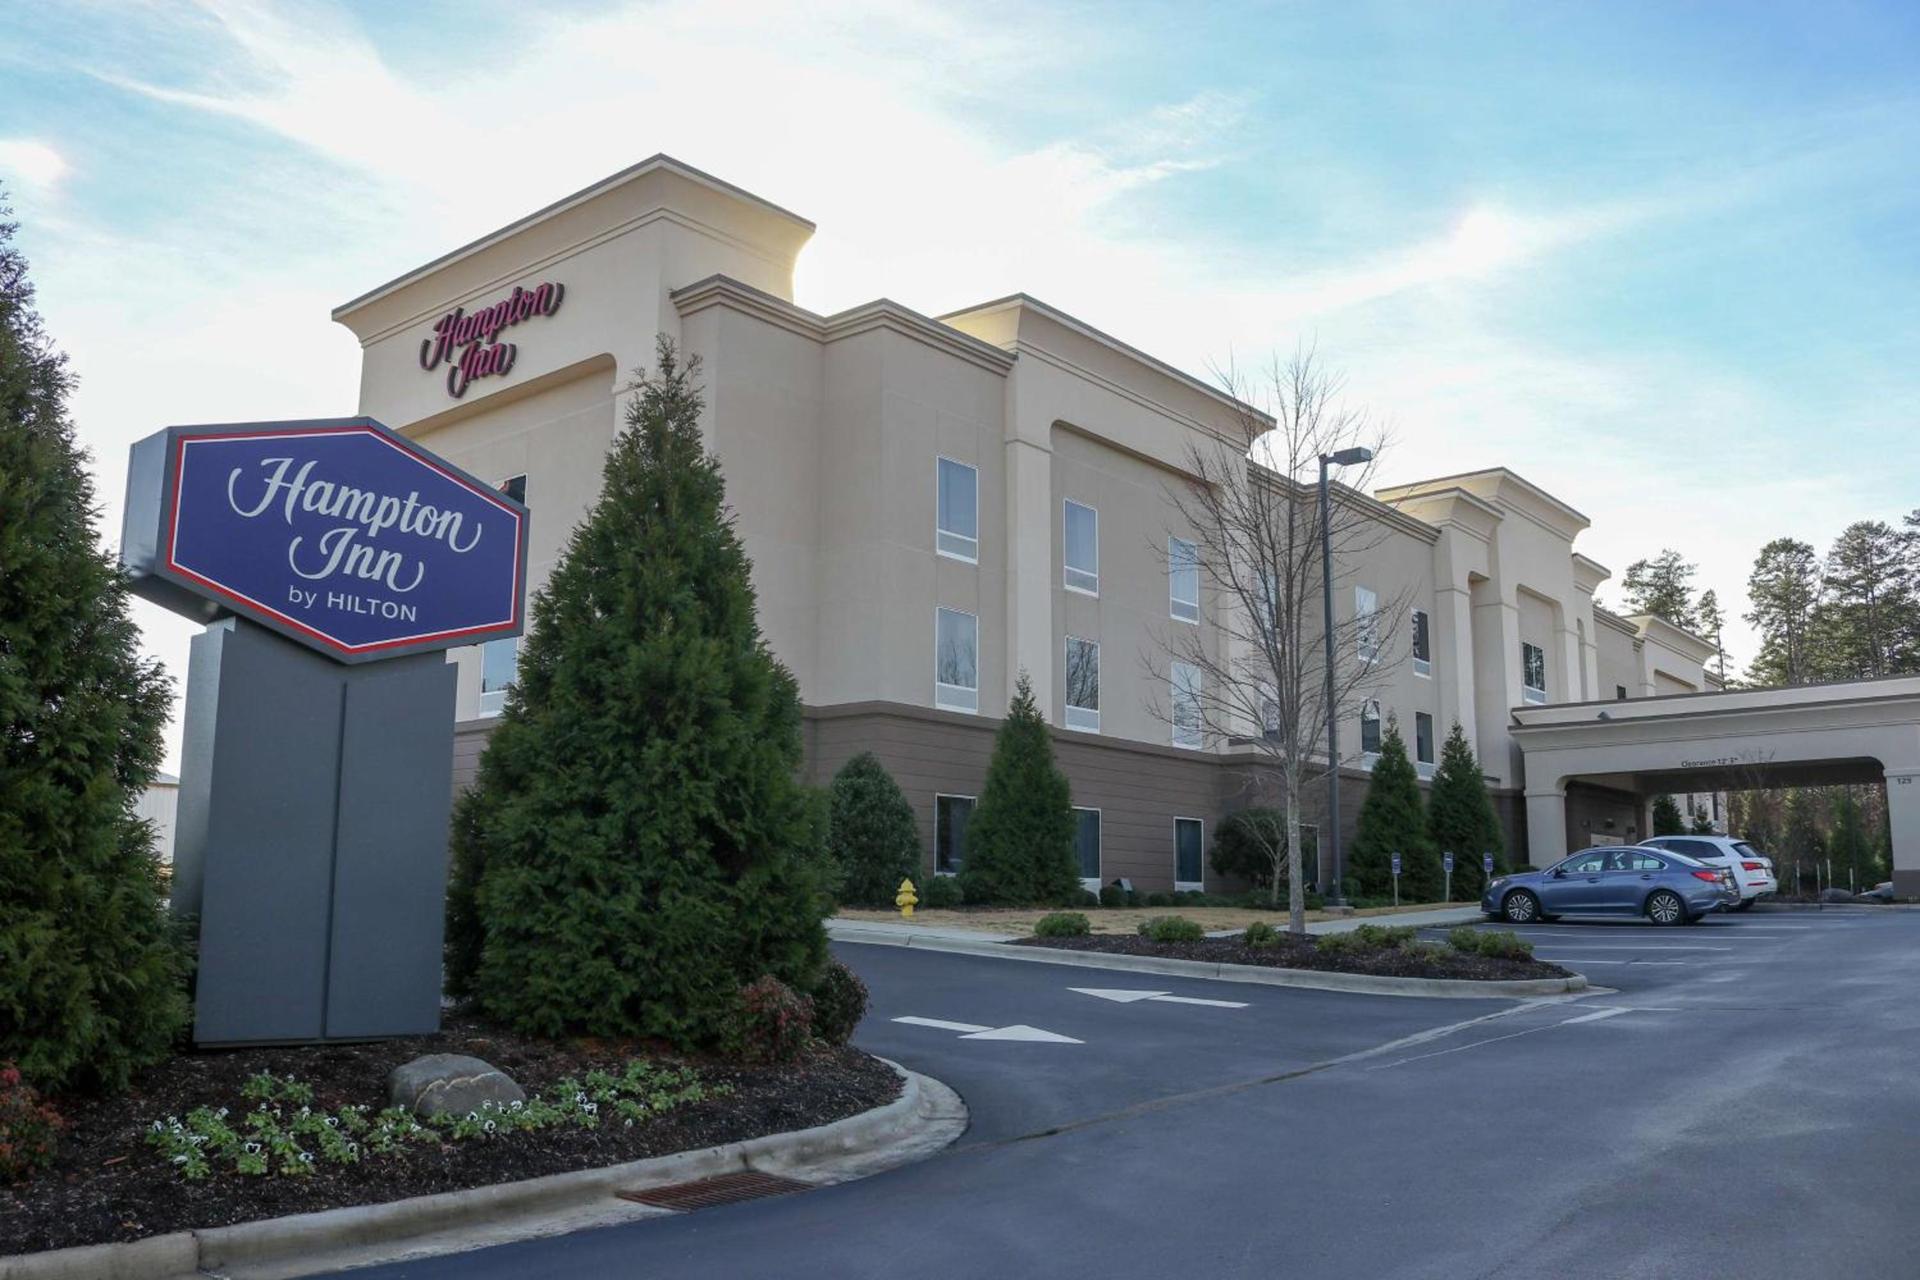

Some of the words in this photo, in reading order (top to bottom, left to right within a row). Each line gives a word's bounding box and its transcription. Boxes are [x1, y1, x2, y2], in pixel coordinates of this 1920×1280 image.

[419, 282, 565, 371] Hampton
[447, 340, 517, 399] Inn
[228, 457, 482, 553] Hampton
[289, 528, 424, 592] Inn
[288, 585, 317, 609] by
[327, 591, 417, 622] HILTON
